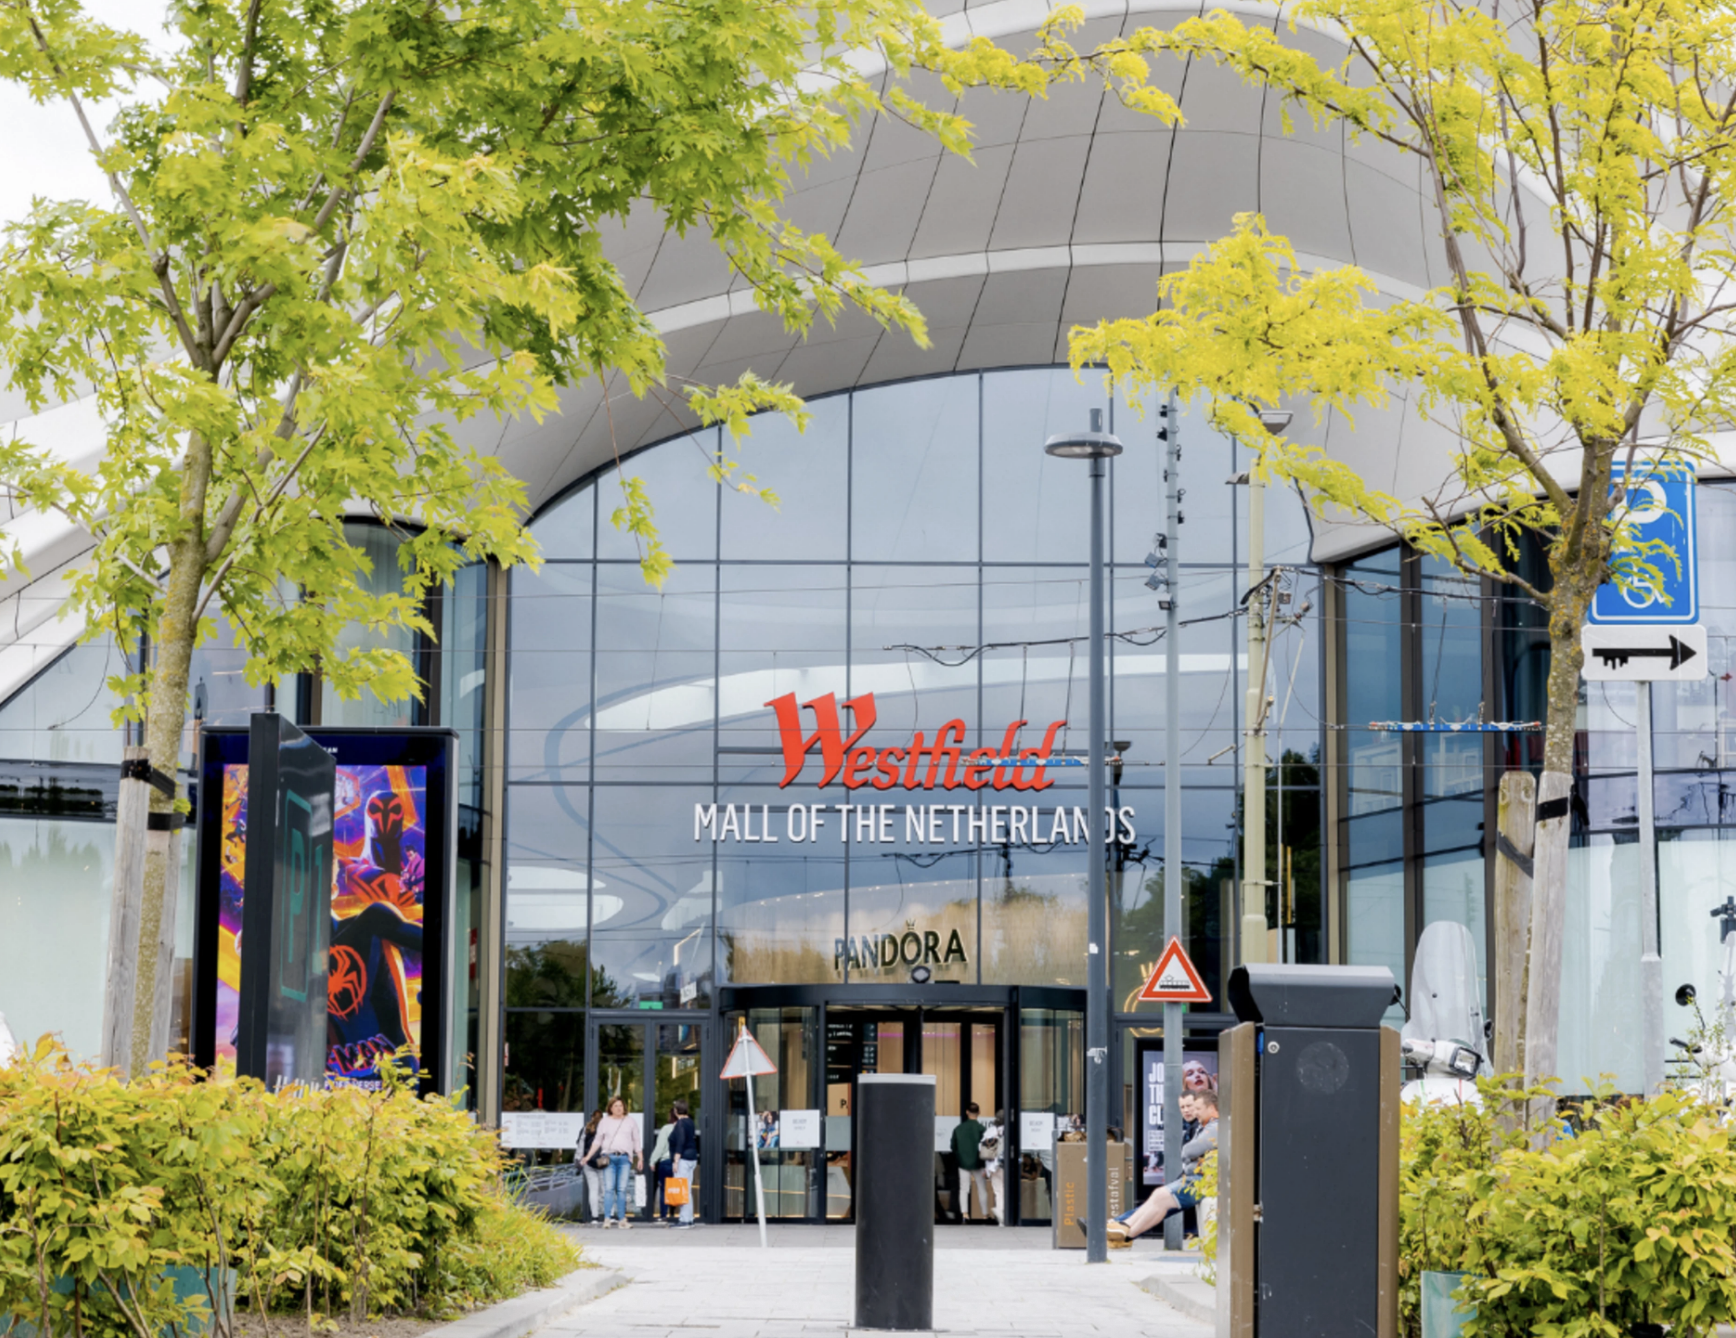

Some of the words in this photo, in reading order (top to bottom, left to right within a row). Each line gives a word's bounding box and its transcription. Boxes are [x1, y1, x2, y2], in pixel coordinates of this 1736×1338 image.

[764, 692, 1067, 791] Westfield
[693, 803, 778, 842] MALL
[787, 803, 826, 842] OF
[835, 804, 895, 843] THE
[905, 804, 1136, 845] NETHERLANDS
[834, 928, 968, 970] PANDORA
[1064, 1182, 1075, 1226] Plastic
[1108, 1167, 1119, 1218] estafval
